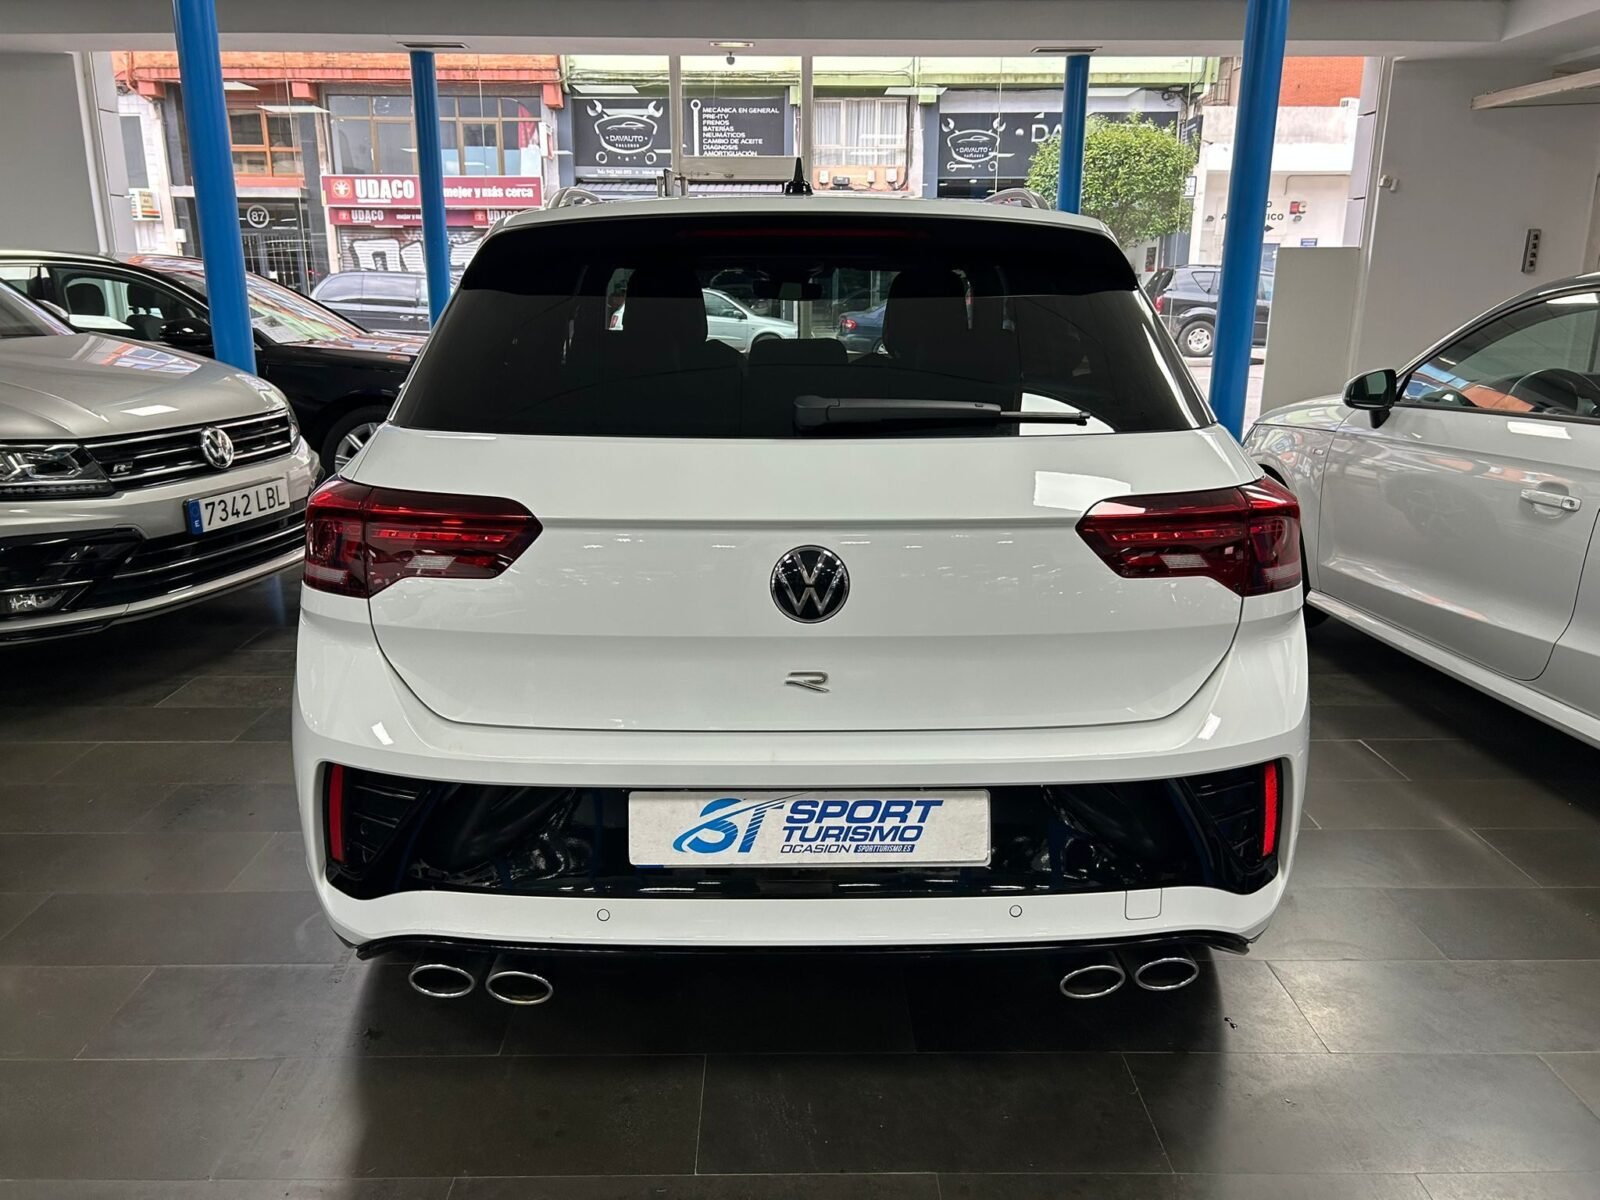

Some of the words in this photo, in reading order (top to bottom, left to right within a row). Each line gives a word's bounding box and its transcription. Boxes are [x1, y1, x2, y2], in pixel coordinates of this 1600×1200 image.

[702, 106, 737, 114] MECÁNICA
[354, 178, 415, 200] UDACO
[474, 187, 481, 199] y
[481, 185, 504, 198] más
[505, 187, 534, 198] cerca
[250, 211, 265, 222] 87
[351, 209, 384, 221] UDACO
[204, 493, 252, 526] 7342
[255, 484, 286, 512] LBL
[784, 671, 831, 694] R
[785, 799, 944, 824] SPORT
[782, 825, 924, 843] TURISMO
[780, 844, 851, 854] OCASION
